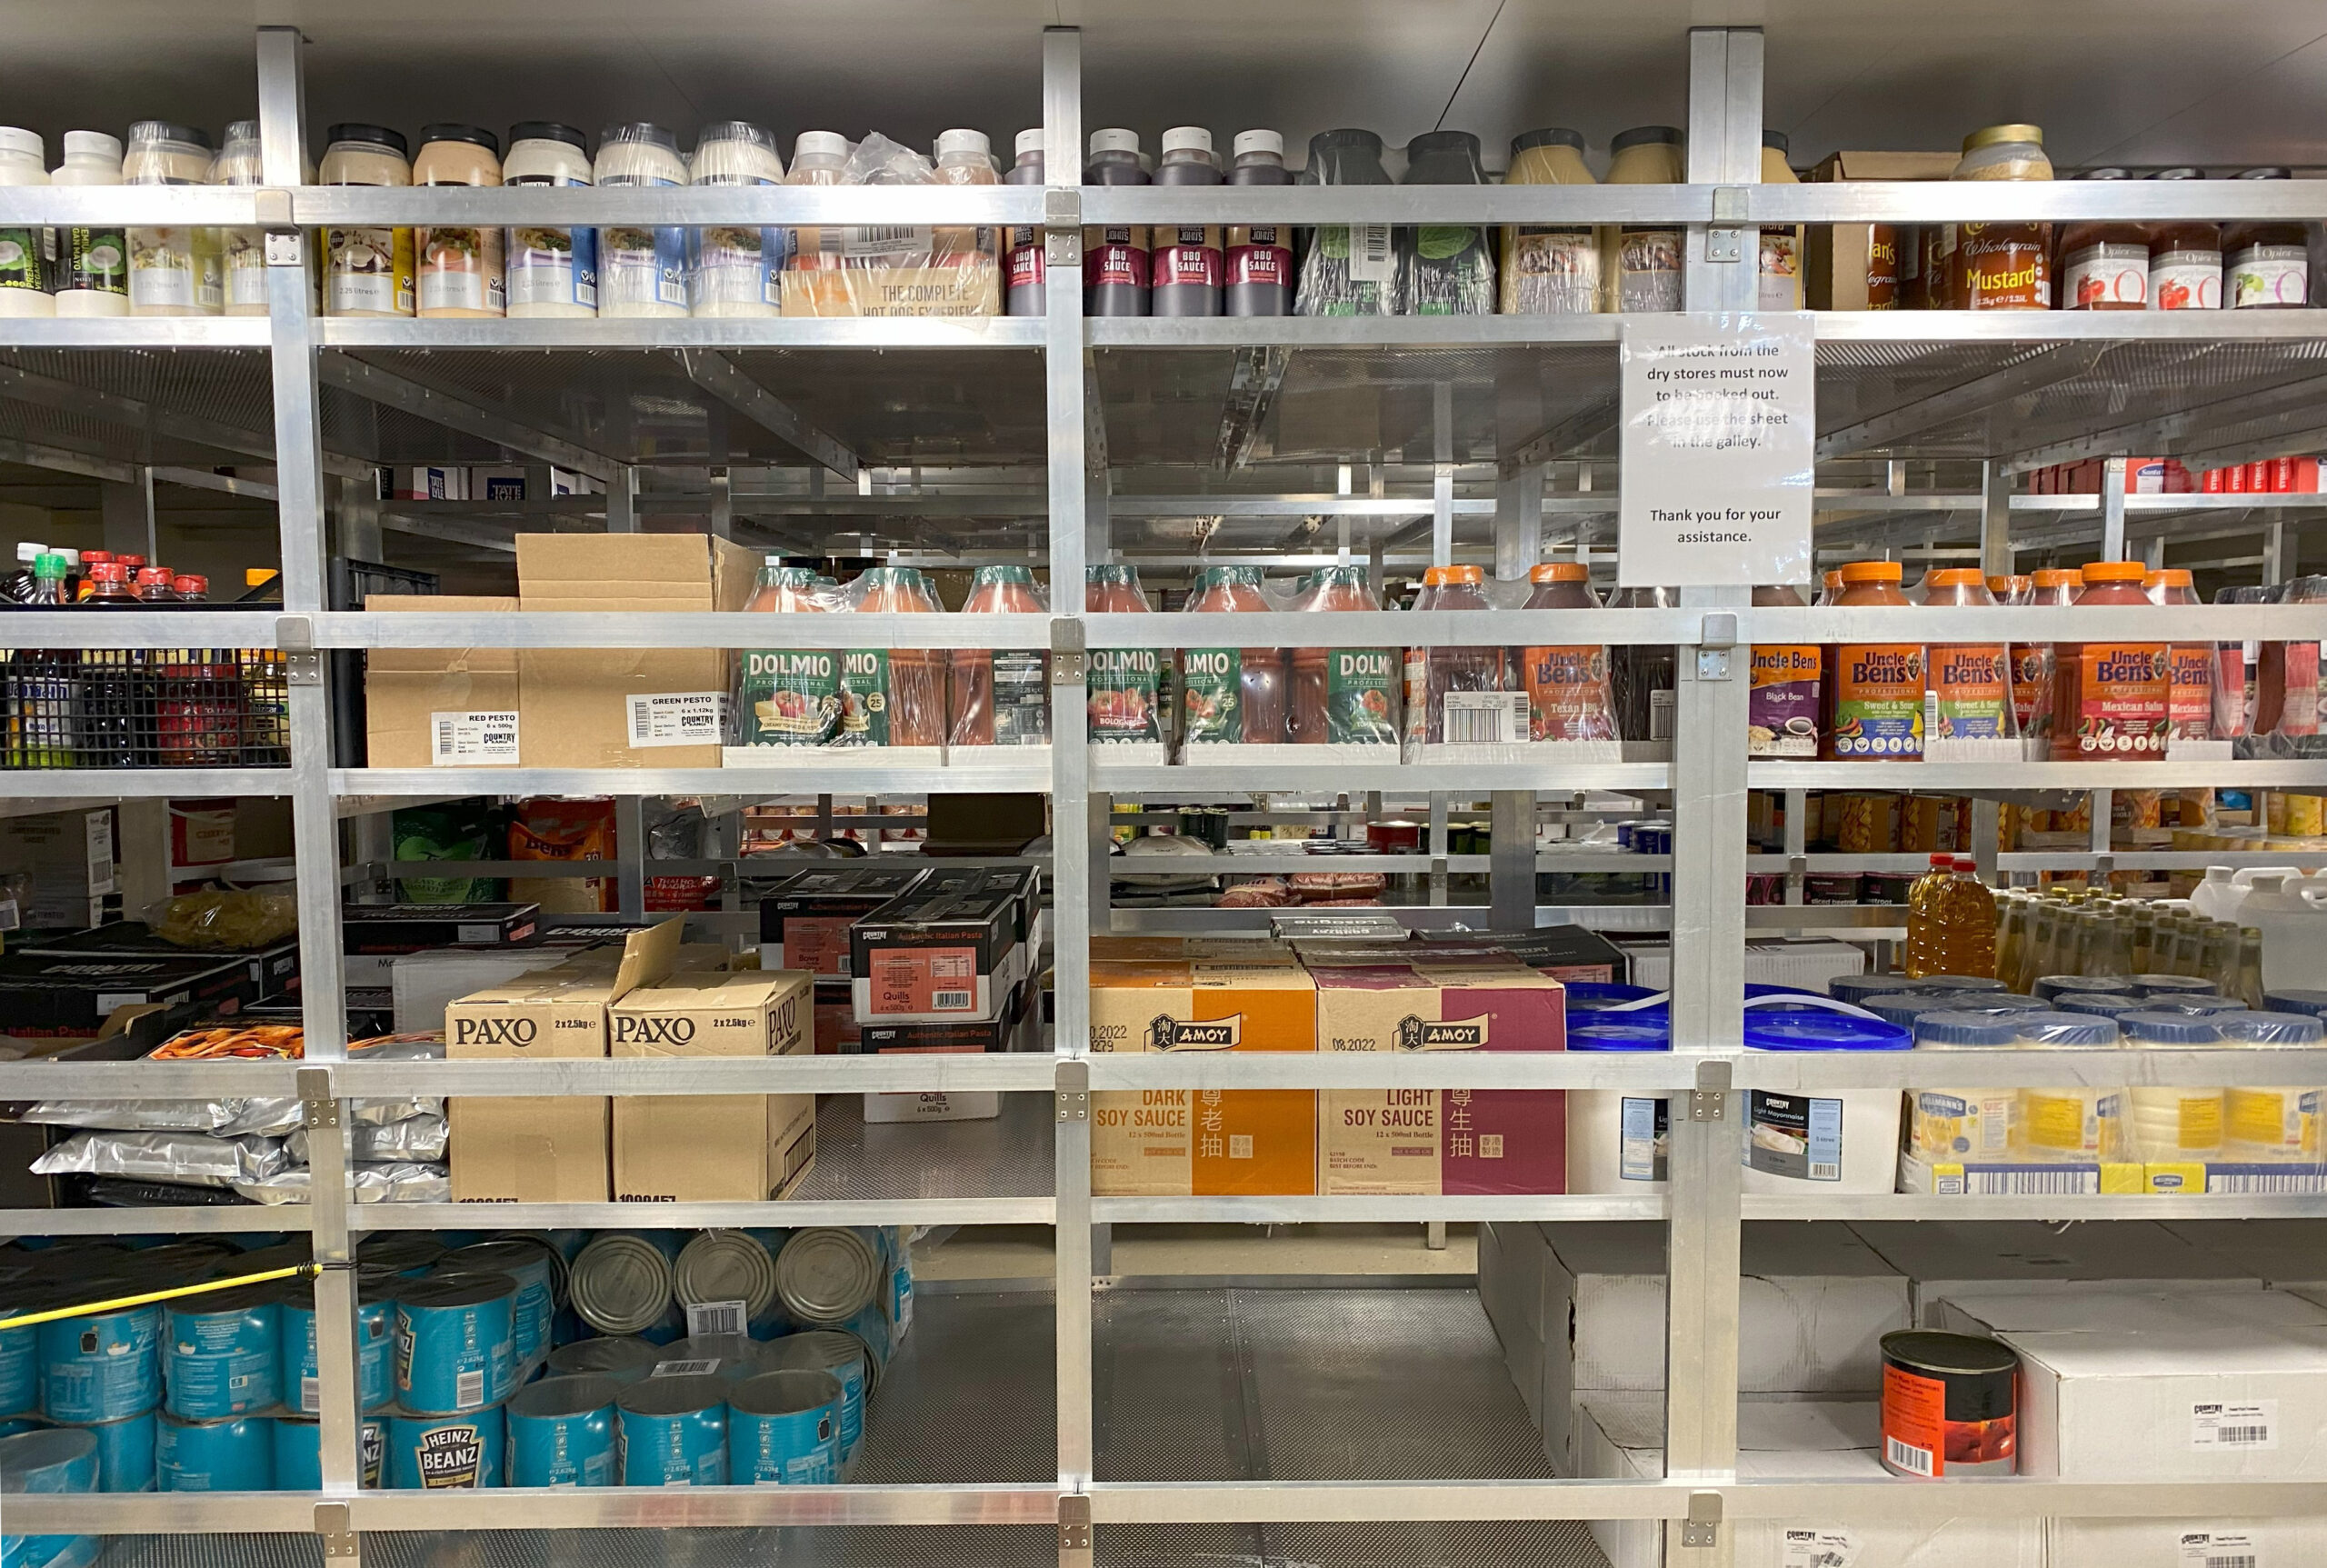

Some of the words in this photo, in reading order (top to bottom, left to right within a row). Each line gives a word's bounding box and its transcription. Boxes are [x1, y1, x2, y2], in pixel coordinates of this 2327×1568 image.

[1962, 238, 2041, 255] Wholegrain
[1104, 262, 1130, 272] SAUCE
[1178, 262, 1204, 272] SAUCE
[1249, 262, 1275, 272] SAUCE
[1967, 264, 2035, 290] Mustard
[882, 285, 902, 302] THE
[1757, 345, 1779, 356] the
[1647, 368, 1670, 382] dry
[1674, 368, 1716, 379] stores
[1720, 368, 1754, 379] must
[1759, 368, 1789, 379] now
[1656, 390, 1671, 402] to
[1674, 388, 1693, 401] be
[1752, 390, 1780, 400] out.
[1724, 413, 1746, 425] the
[1751, 413, 1788, 425] sheet
[1673, 435, 1686, 448] in
[1691, 435, 1713, 448] the
[1717, 435, 1761, 450] galley.
[430, 474, 444, 487] TATE
[492, 484, 521, 494] TATE
[1651, 509, 1693, 522] Thank
[1696, 510, 1721, 524] you
[1726, 509, 1745, 521] for
[1750, 510, 1782, 522] your
[1677, 530, 1752, 544] assistance.
[1549, 653, 1589, 667] Uncle
[1751, 650, 1789, 668] Uncle
[1793, 652, 1817, 670] Ben's
[1865, 652, 1905, 665] Uncle
[1955, 654, 1992, 667] Uncle
[2112, 651, 2152, 665] Uncle
[750, 654, 831, 676] DOLMIO
[1537, 664, 1590, 684] Ben's
[1853, 663, 1906, 684] Ben's
[1942, 664, 1992, 684] Ben's
[2097, 662, 2152, 682] Ben's
[871, 698, 882, 708] 25
[1222, 697, 1234, 707] 25
[1766, 692, 1786, 701] Black
[1787, 692, 1804, 701] Bean
[1550, 703, 1580, 714] Texan
[1863, 701, 1889, 710] Sweet
[1892, 701, 1898, 710] &
[1899, 701, 1914, 710] Sour
[1954, 701, 1978, 710] Sweet
[1980, 702, 1985, 710] &
[2102, 702, 2142, 713] Mexican
[2170, 704, 2203, 714] Mexican
[682, 715, 714, 726] COUNTRY
[484, 733, 515, 744] COUNTRY
[777, 902, 799, 910] COUNTRY
[863, 931, 887, 940] COUNTRY
[898, 932, 934, 940] Authentic
[935, 932, 960, 940] Italian
[961, 931, 983, 939] Pasta
[799, 954, 819, 963] Bows
[883, 991, 910, 1001] Quills
[890, 1004, 904, 1012] 500g
[554, 1020, 561, 1029] 2
[566, 1019, 588, 1030] 2.5kg
[714, 1019, 719, 1027] 2
[724, 1018, 746, 1029] 2.5kg
[768, 995, 796, 1050] PAXO
[7, 1026, 55, 1037] Italian
[455, 1017, 537, 1048] PAXO
[614, 1016, 695, 1046] PAXO
[872, 1030, 895, 1040] COUNTRY
[907, 1032, 943, 1040] Authentic
[944, 1031, 968, 1039] Italian
[971, 1030, 991, 1038] Pasta
[1179, 1027, 1228, 1043] AMOY
[1428, 1026, 1476, 1043] AMOY
[1332, 1038, 1376, 1052] 08.2022
[920, 1094, 946, 1102] Quills
[1143, 1090, 1185, 1105] DARK
[1387, 1089, 1433, 1106] LIGHT
[1766, 1098, 1789, 1110] COUNTRY
[1097, 1110, 1129, 1127] SOY
[1134, 1110, 1185, 1127] SAUCE
[1344, 1110, 1376, 1126] SOY
[1382, 1110, 1433, 1126] SAUCE
[1753, 1106, 1767, 1114] Light
[1768, 1109, 1804, 1121] Mayonnaise
[2194, 1404, 2222, 1413] COUNTRY
[429, 1429, 470, 1448] HEINZ
[423, 1446, 477, 1469] BEANZ
[1786, 1530, 1817, 1542] COUNTRY
[2181, 1533, 2211, 1543] COUNTRY
